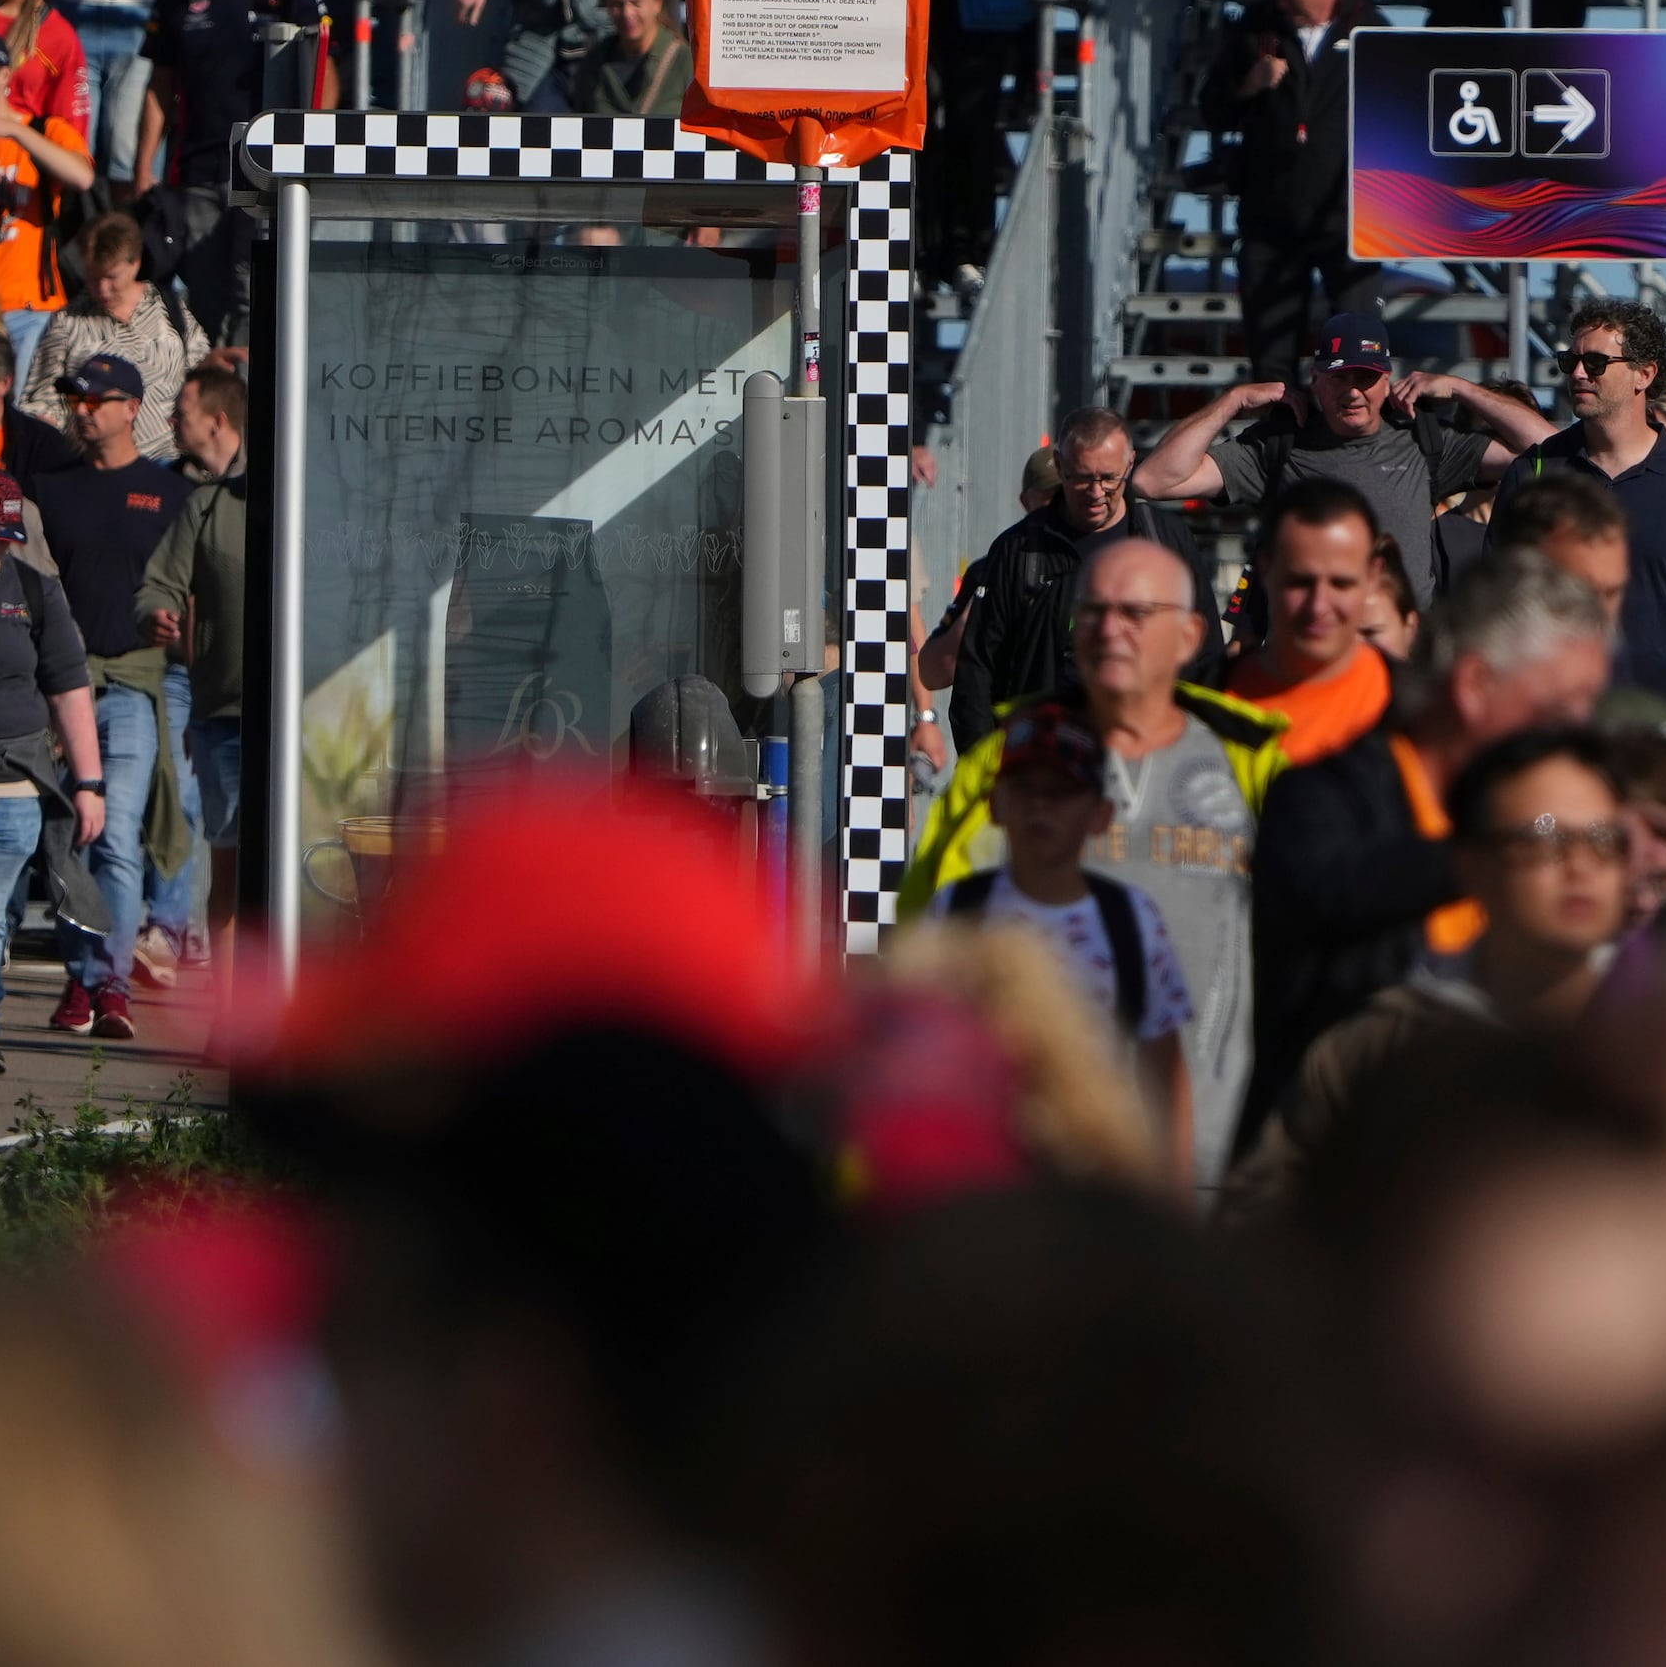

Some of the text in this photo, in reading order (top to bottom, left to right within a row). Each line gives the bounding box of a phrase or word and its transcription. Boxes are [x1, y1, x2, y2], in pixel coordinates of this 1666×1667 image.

[319, 362, 745, 397] KOFFIEBONEN MET
[329, 413, 735, 447] INTENSE AROMA'S
